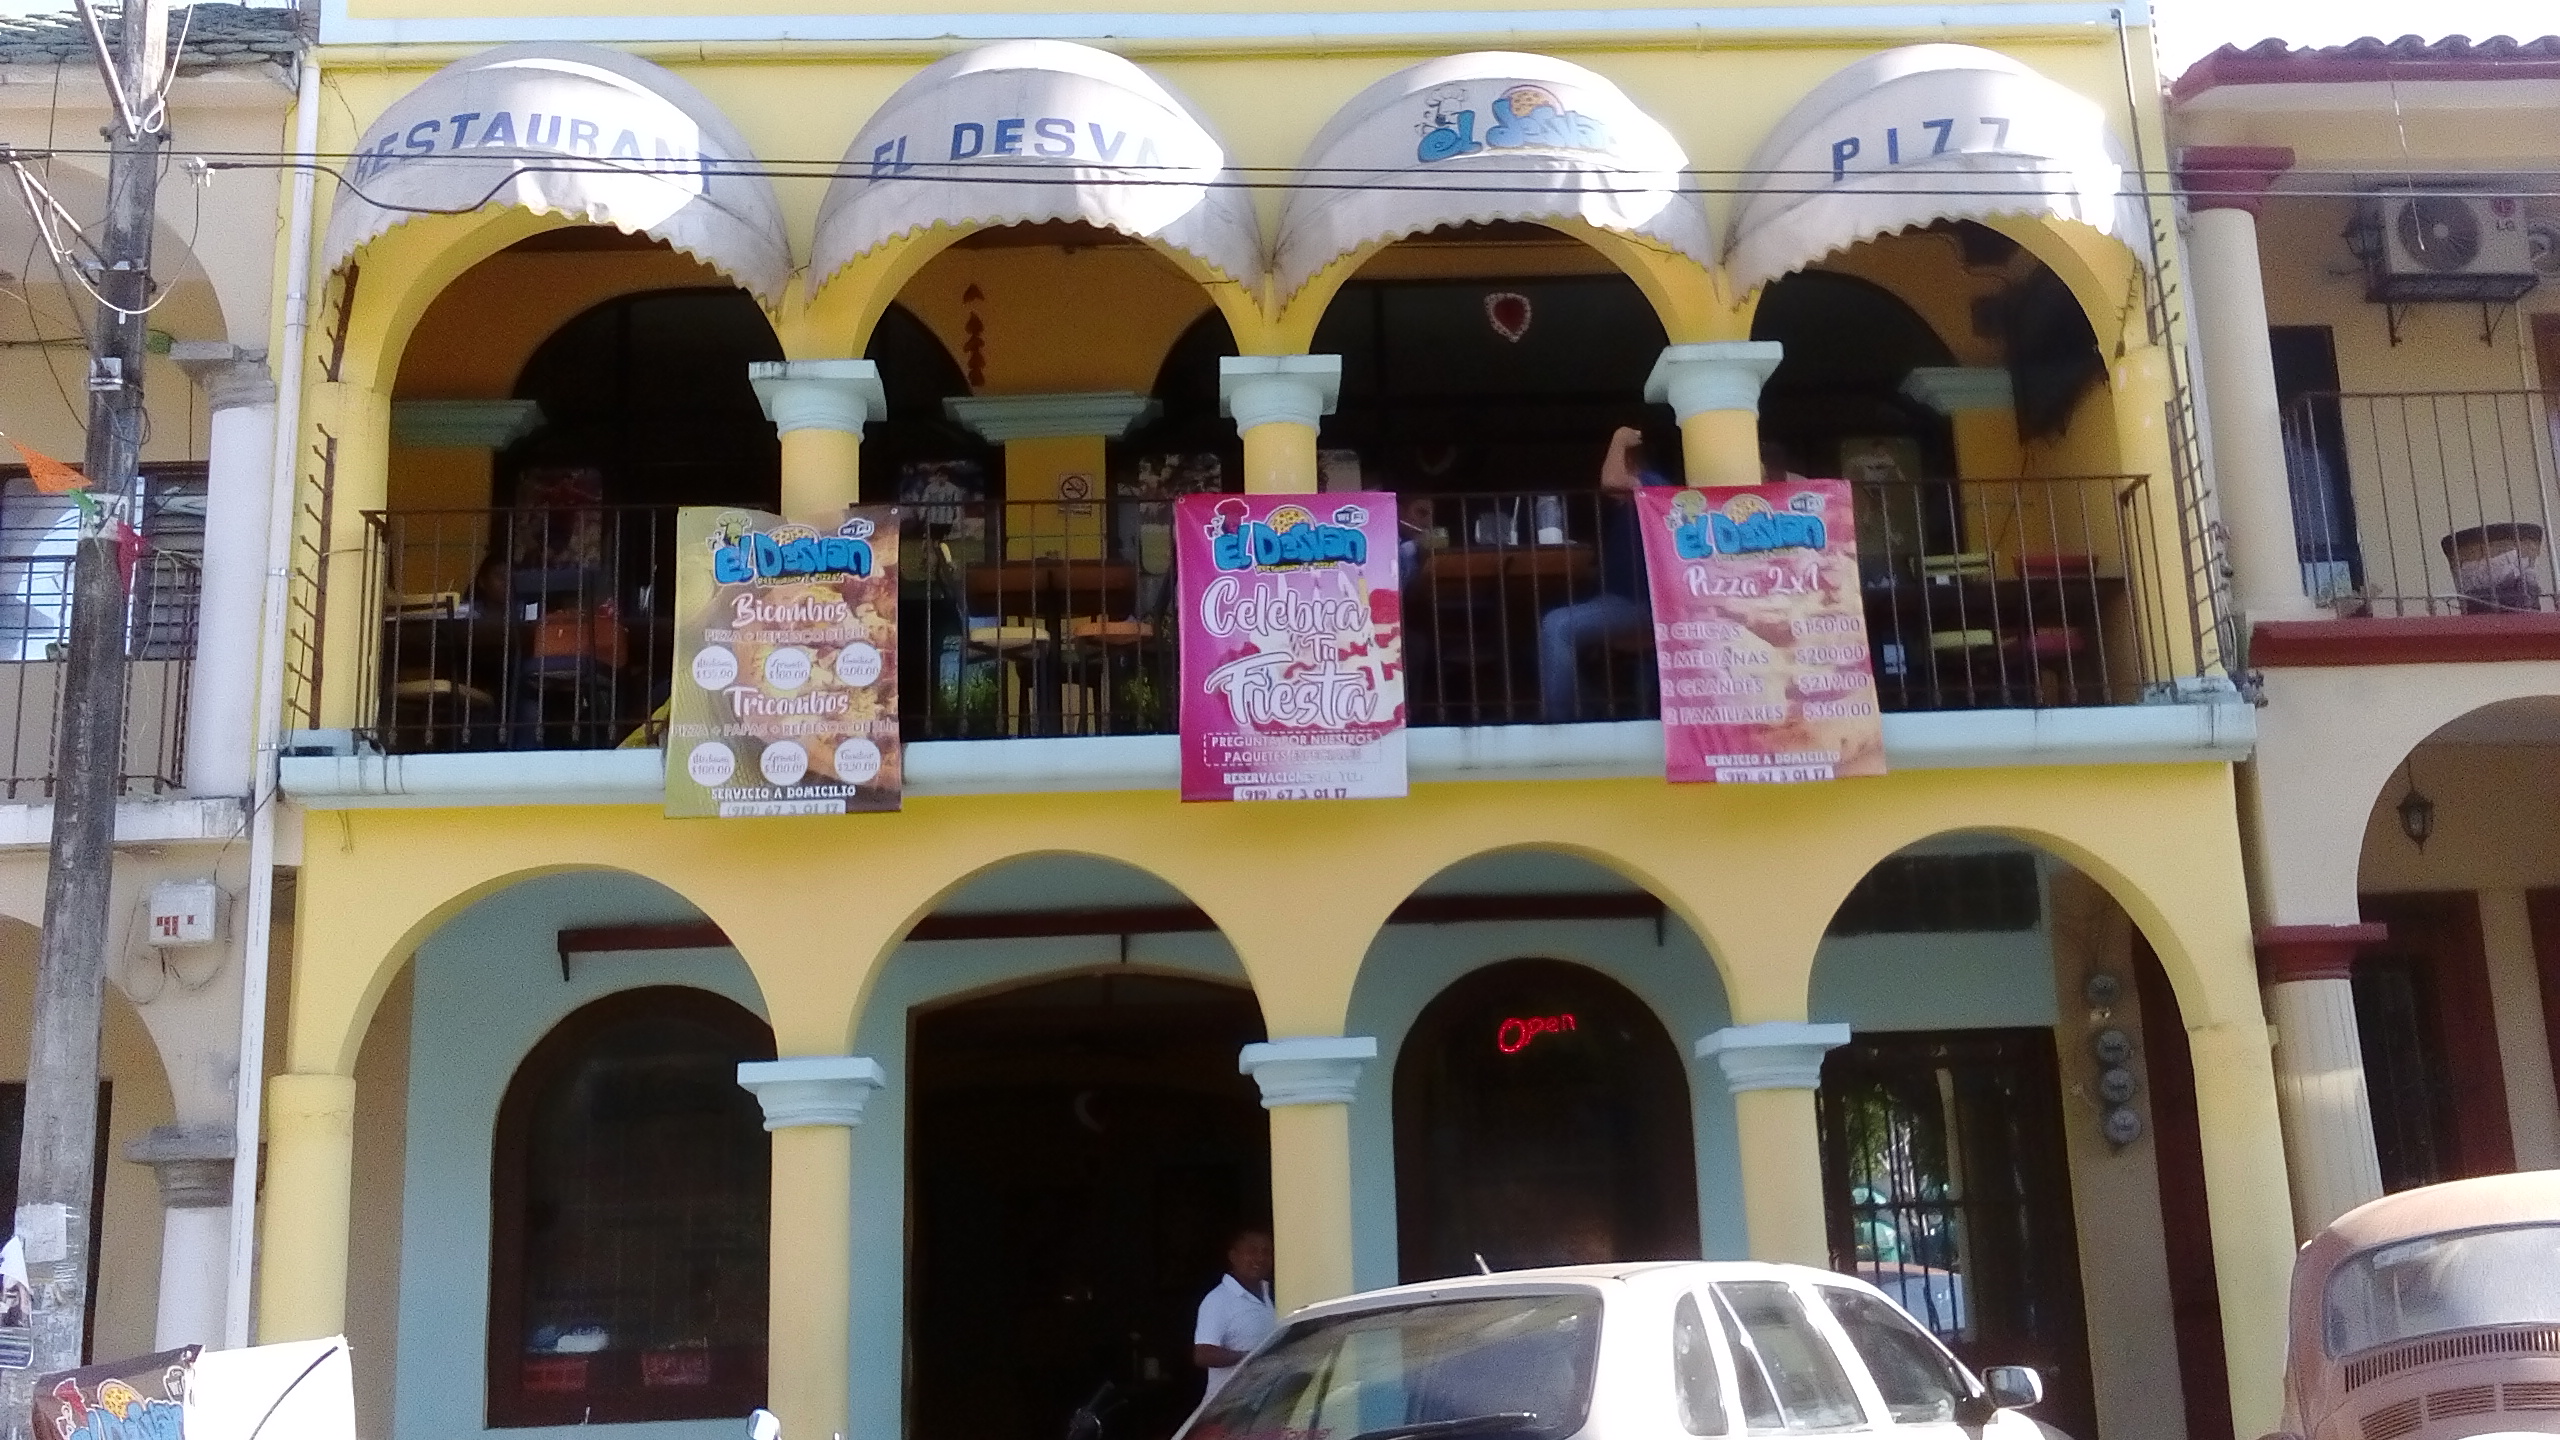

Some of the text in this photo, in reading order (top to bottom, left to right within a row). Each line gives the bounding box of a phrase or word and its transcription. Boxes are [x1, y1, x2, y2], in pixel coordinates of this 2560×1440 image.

[869, 136, 913, 187] EL
[1684, 565, 1759, 598] Pizza
[732, 593, 849, 627] Bicombos
[1202, 576, 1369, 637] Celebra
[1303, 633, 1337, 662] Tu
[1673, 649, 1770, 668] MEDIANAS
[1796, 644, 1865, 664] $200.00
[724, 686, 849, 718] Tricombos
[1204, 651, 1379, 725] Fiesta
[1677, 678, 1764, 697] GRANDES
[1680, 705, 1785, 724] FAMILIARES
[1211, 734, 1374, 748] PREGUNTA POR NUESTROS
[1224, 750, 1286, 763] PAQUETES
[711, 785, 856, 800] SERVICIO A DOMICILIO
[1240, 788, 1272, 800] (919)
[1277, 789, 1293, 799] 67
[1313, 788, 1329, 798] 01
[1334, 788, 1347, 798] 17
[1499, 1014, 1576, 1053] Open
